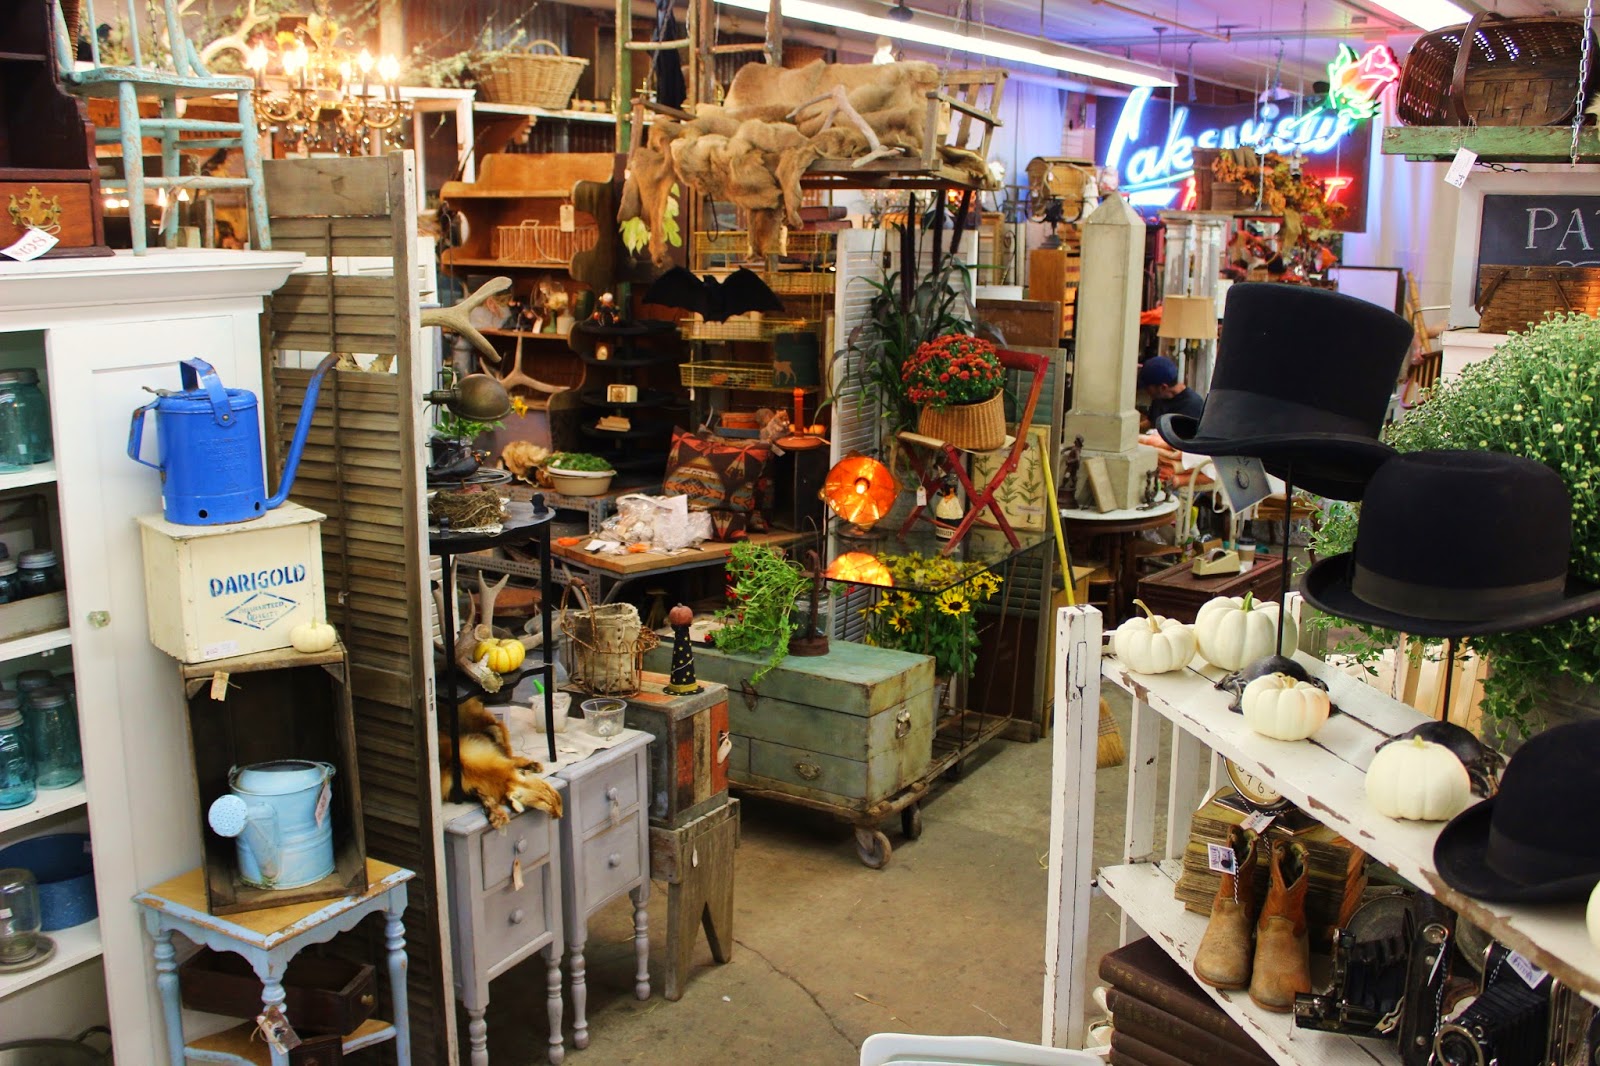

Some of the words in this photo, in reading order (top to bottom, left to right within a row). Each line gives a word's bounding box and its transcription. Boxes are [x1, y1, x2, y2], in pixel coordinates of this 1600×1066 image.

[1525, 207, 1600, 251] PA
[209, 564, 306, 597] DARIGOLD
[1257, 782, 1265, 794] 6
